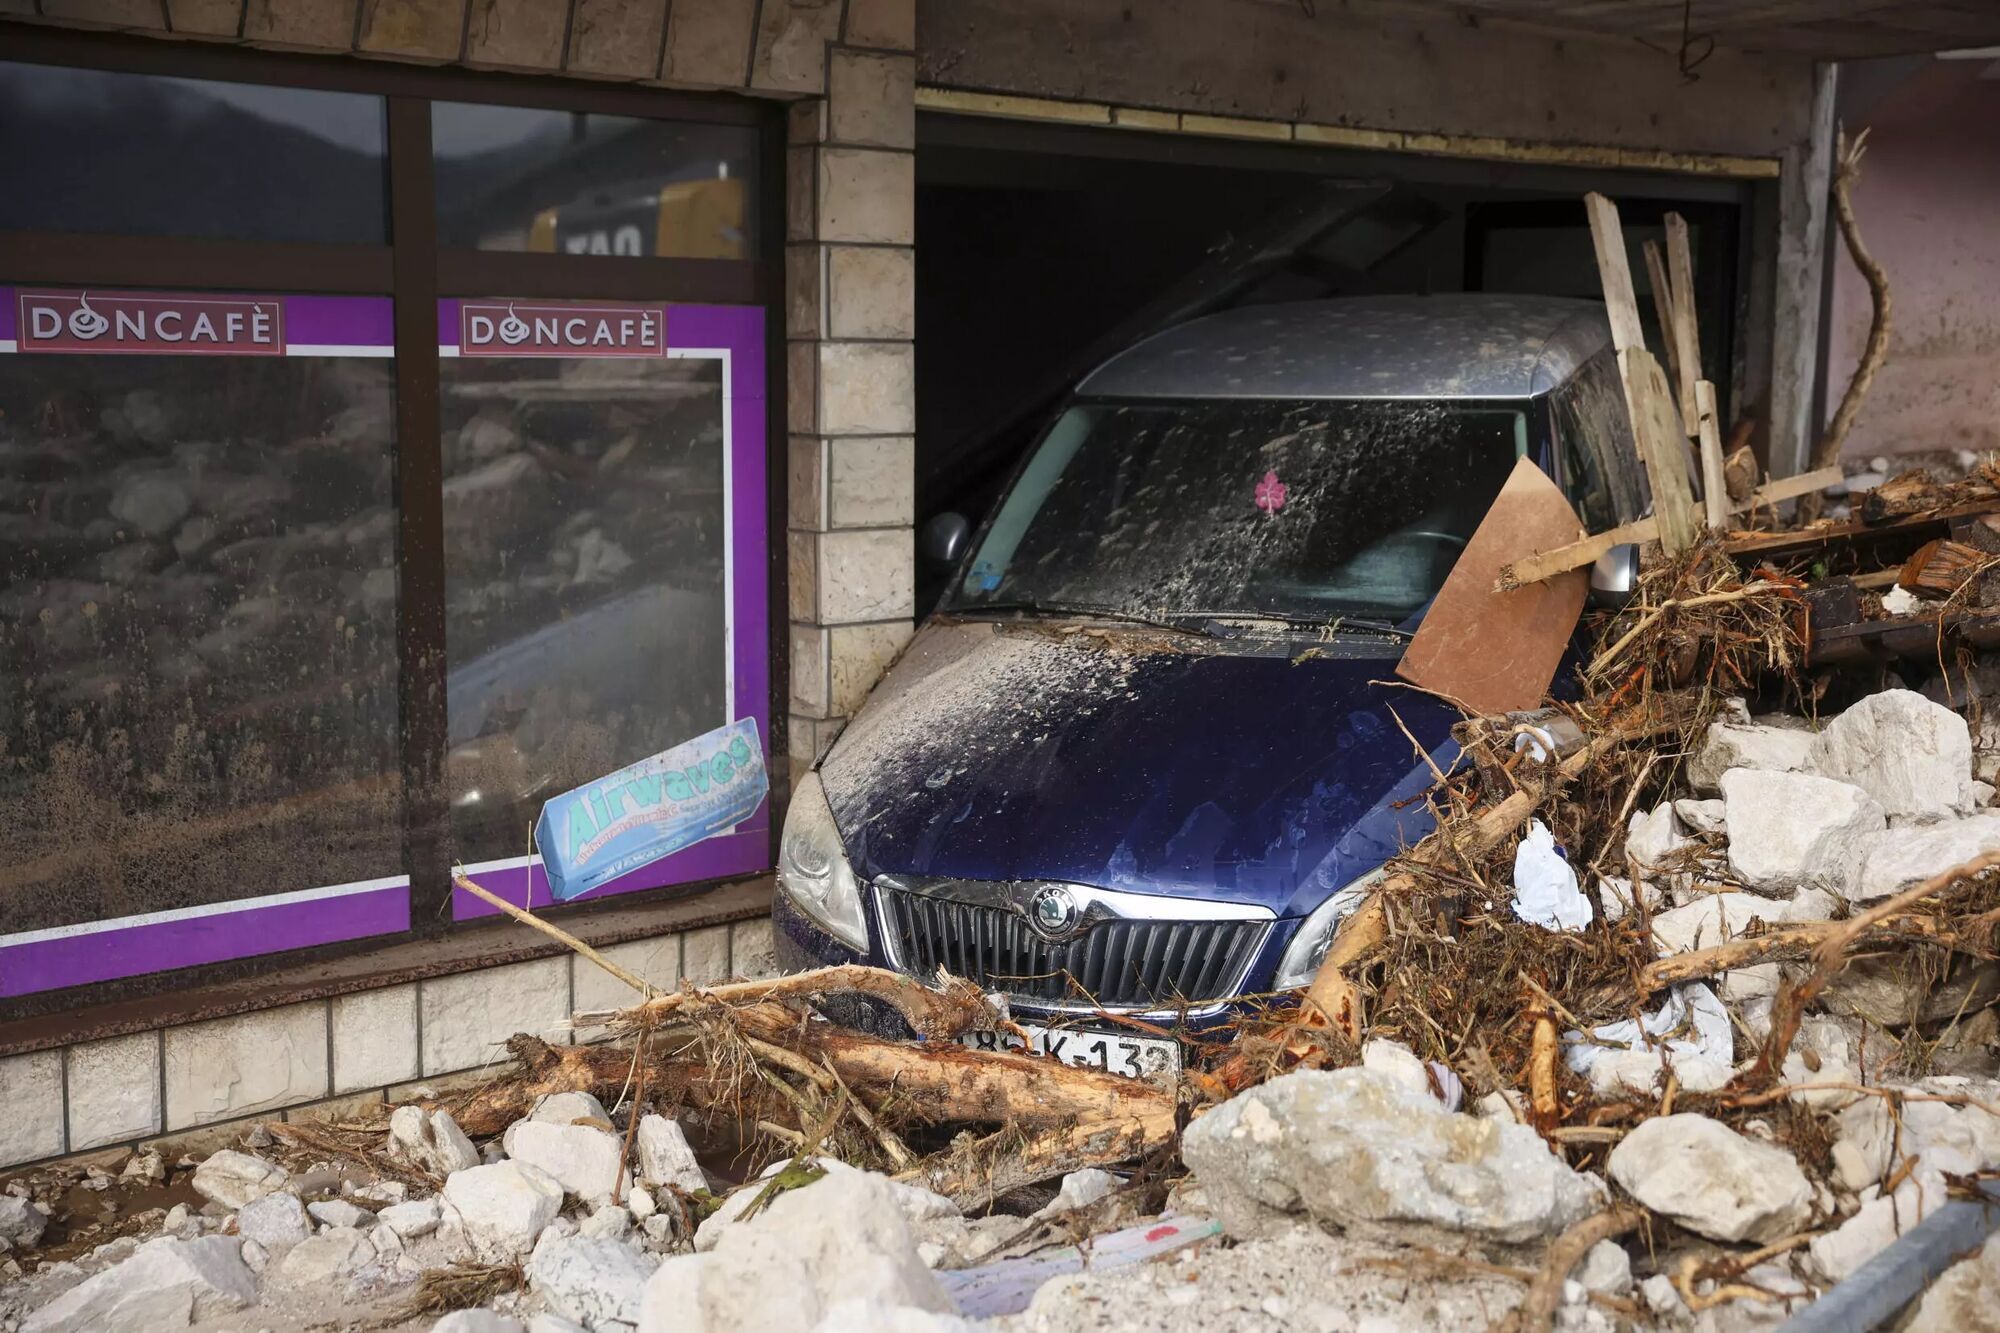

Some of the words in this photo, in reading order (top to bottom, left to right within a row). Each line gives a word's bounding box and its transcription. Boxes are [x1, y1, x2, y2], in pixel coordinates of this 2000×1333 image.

[32, 295, 271, 343] DONCAFÈ
[471, 305, 655, 346] DONCAFÈ
[568, 735, 751, 863] Airwaves
